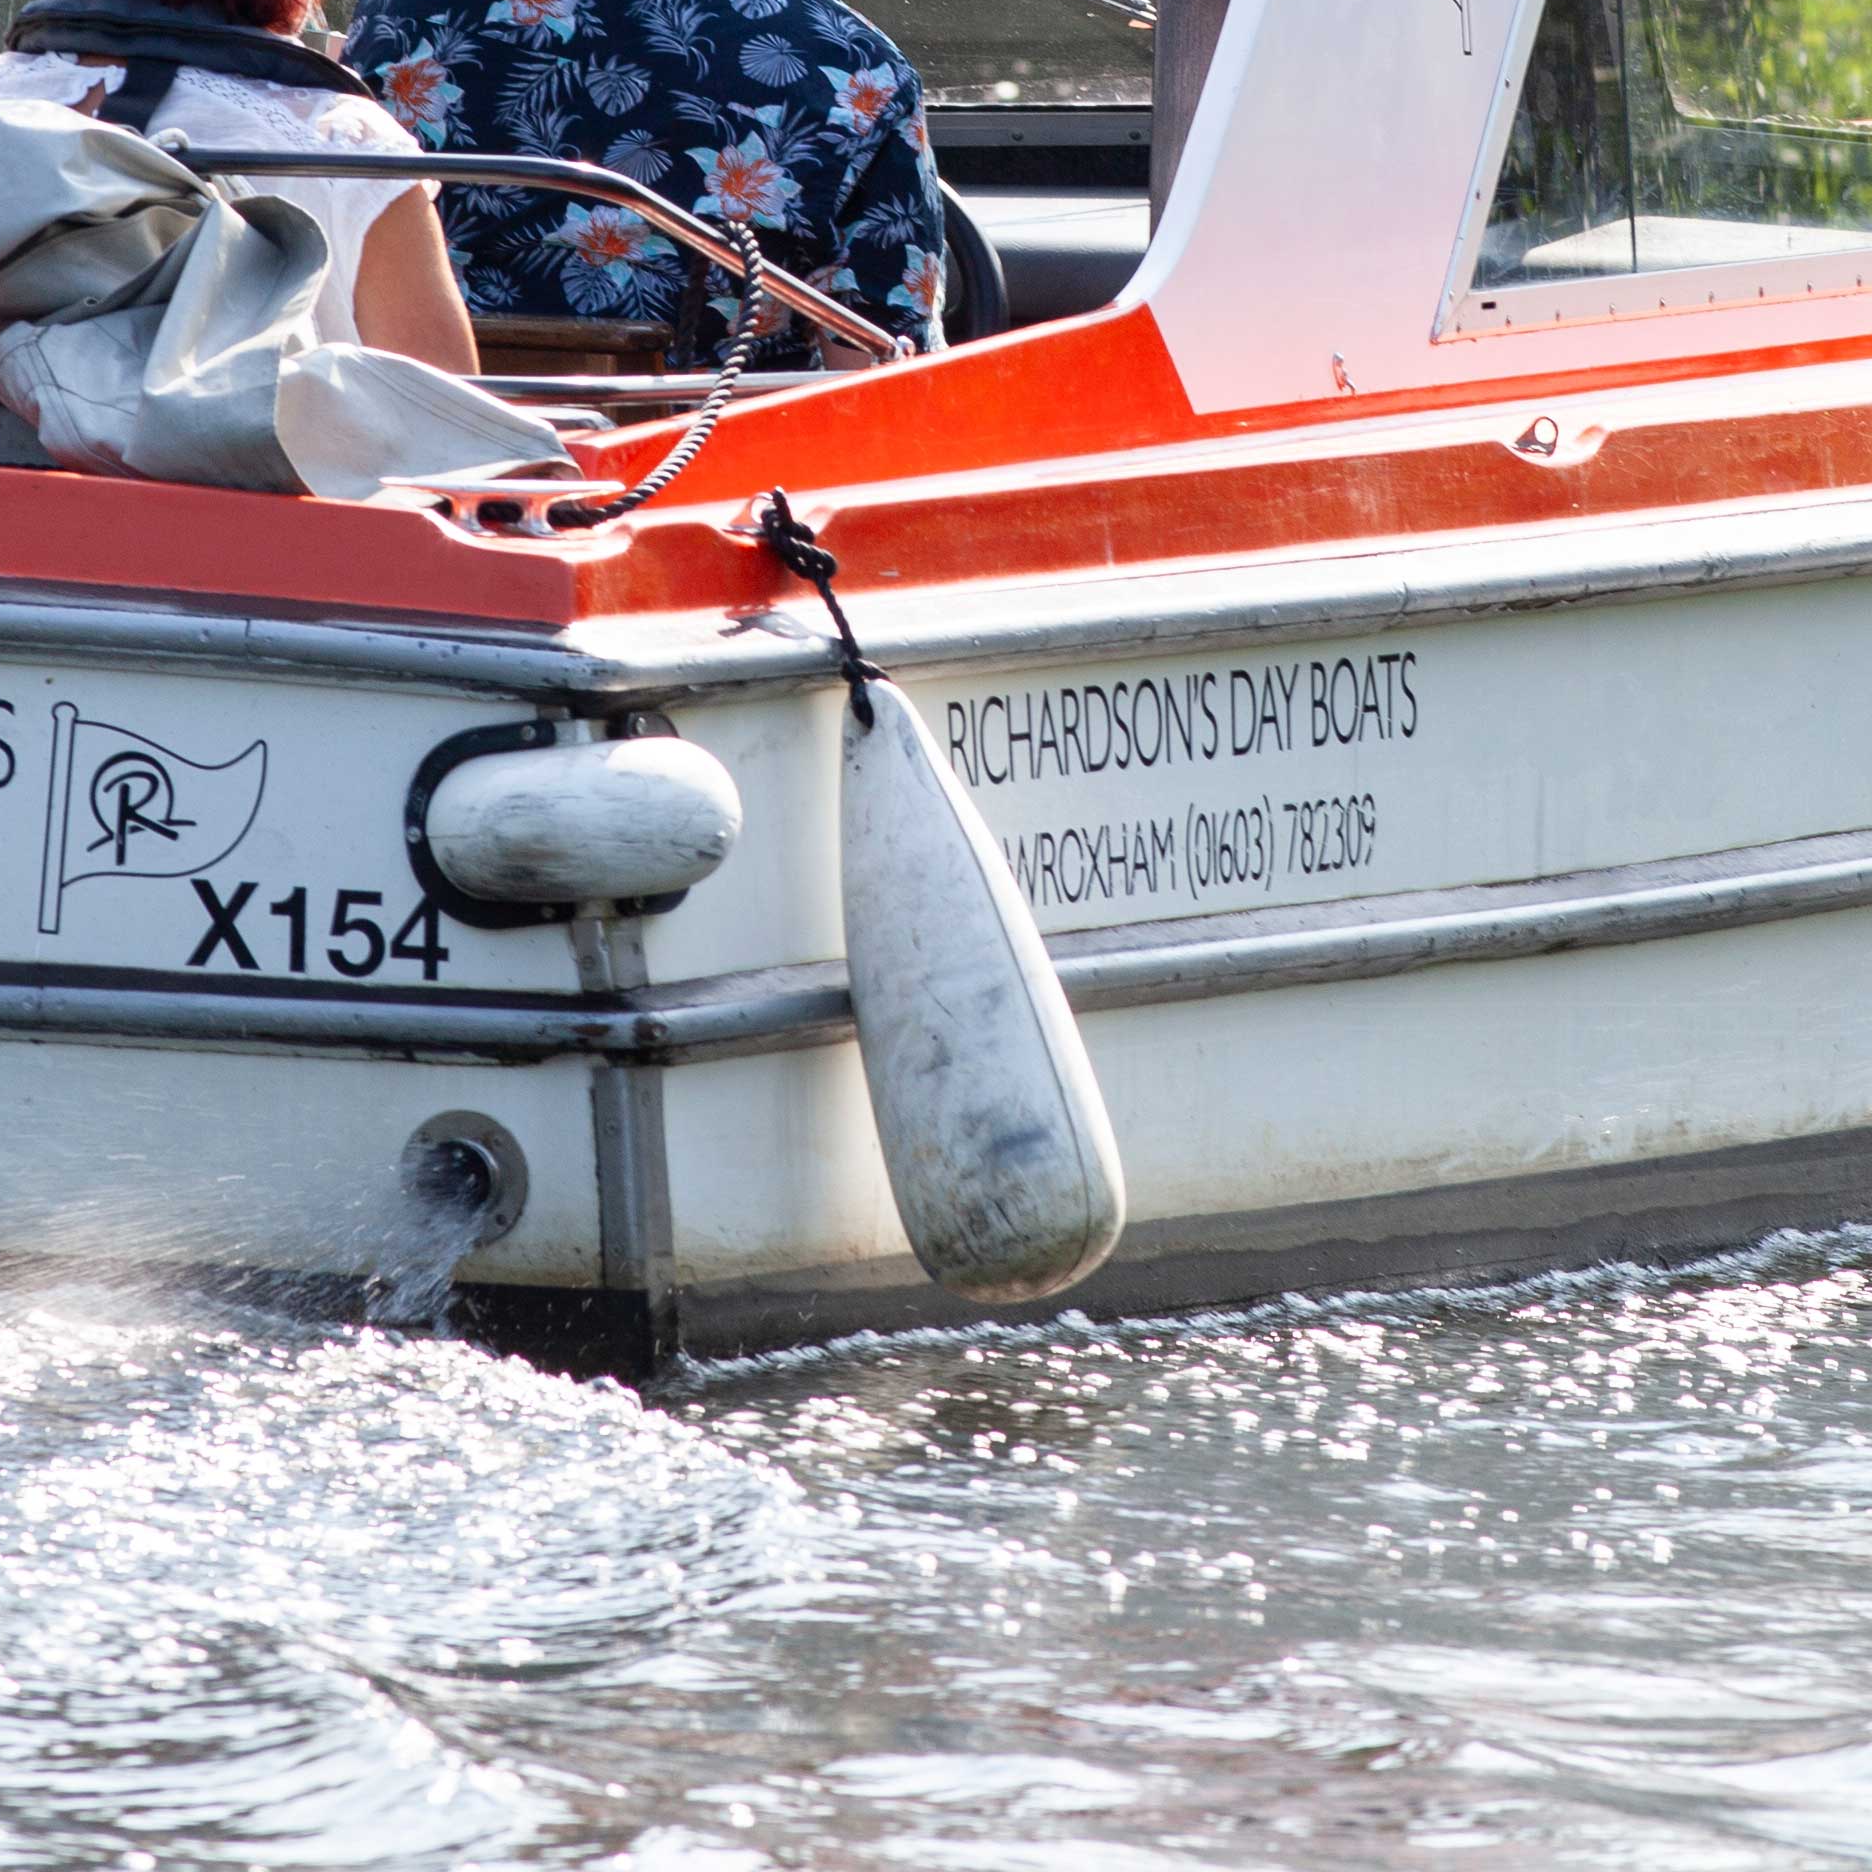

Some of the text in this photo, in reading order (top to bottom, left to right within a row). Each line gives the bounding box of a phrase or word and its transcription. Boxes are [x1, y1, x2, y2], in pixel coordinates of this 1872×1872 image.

[946, 650, 1418, 788] RICHARDSON'S DAY BOATS
[1003, 792, 1377, 907] WROXHAM (01603) 782309
[185, 877, 450, 981] X154
